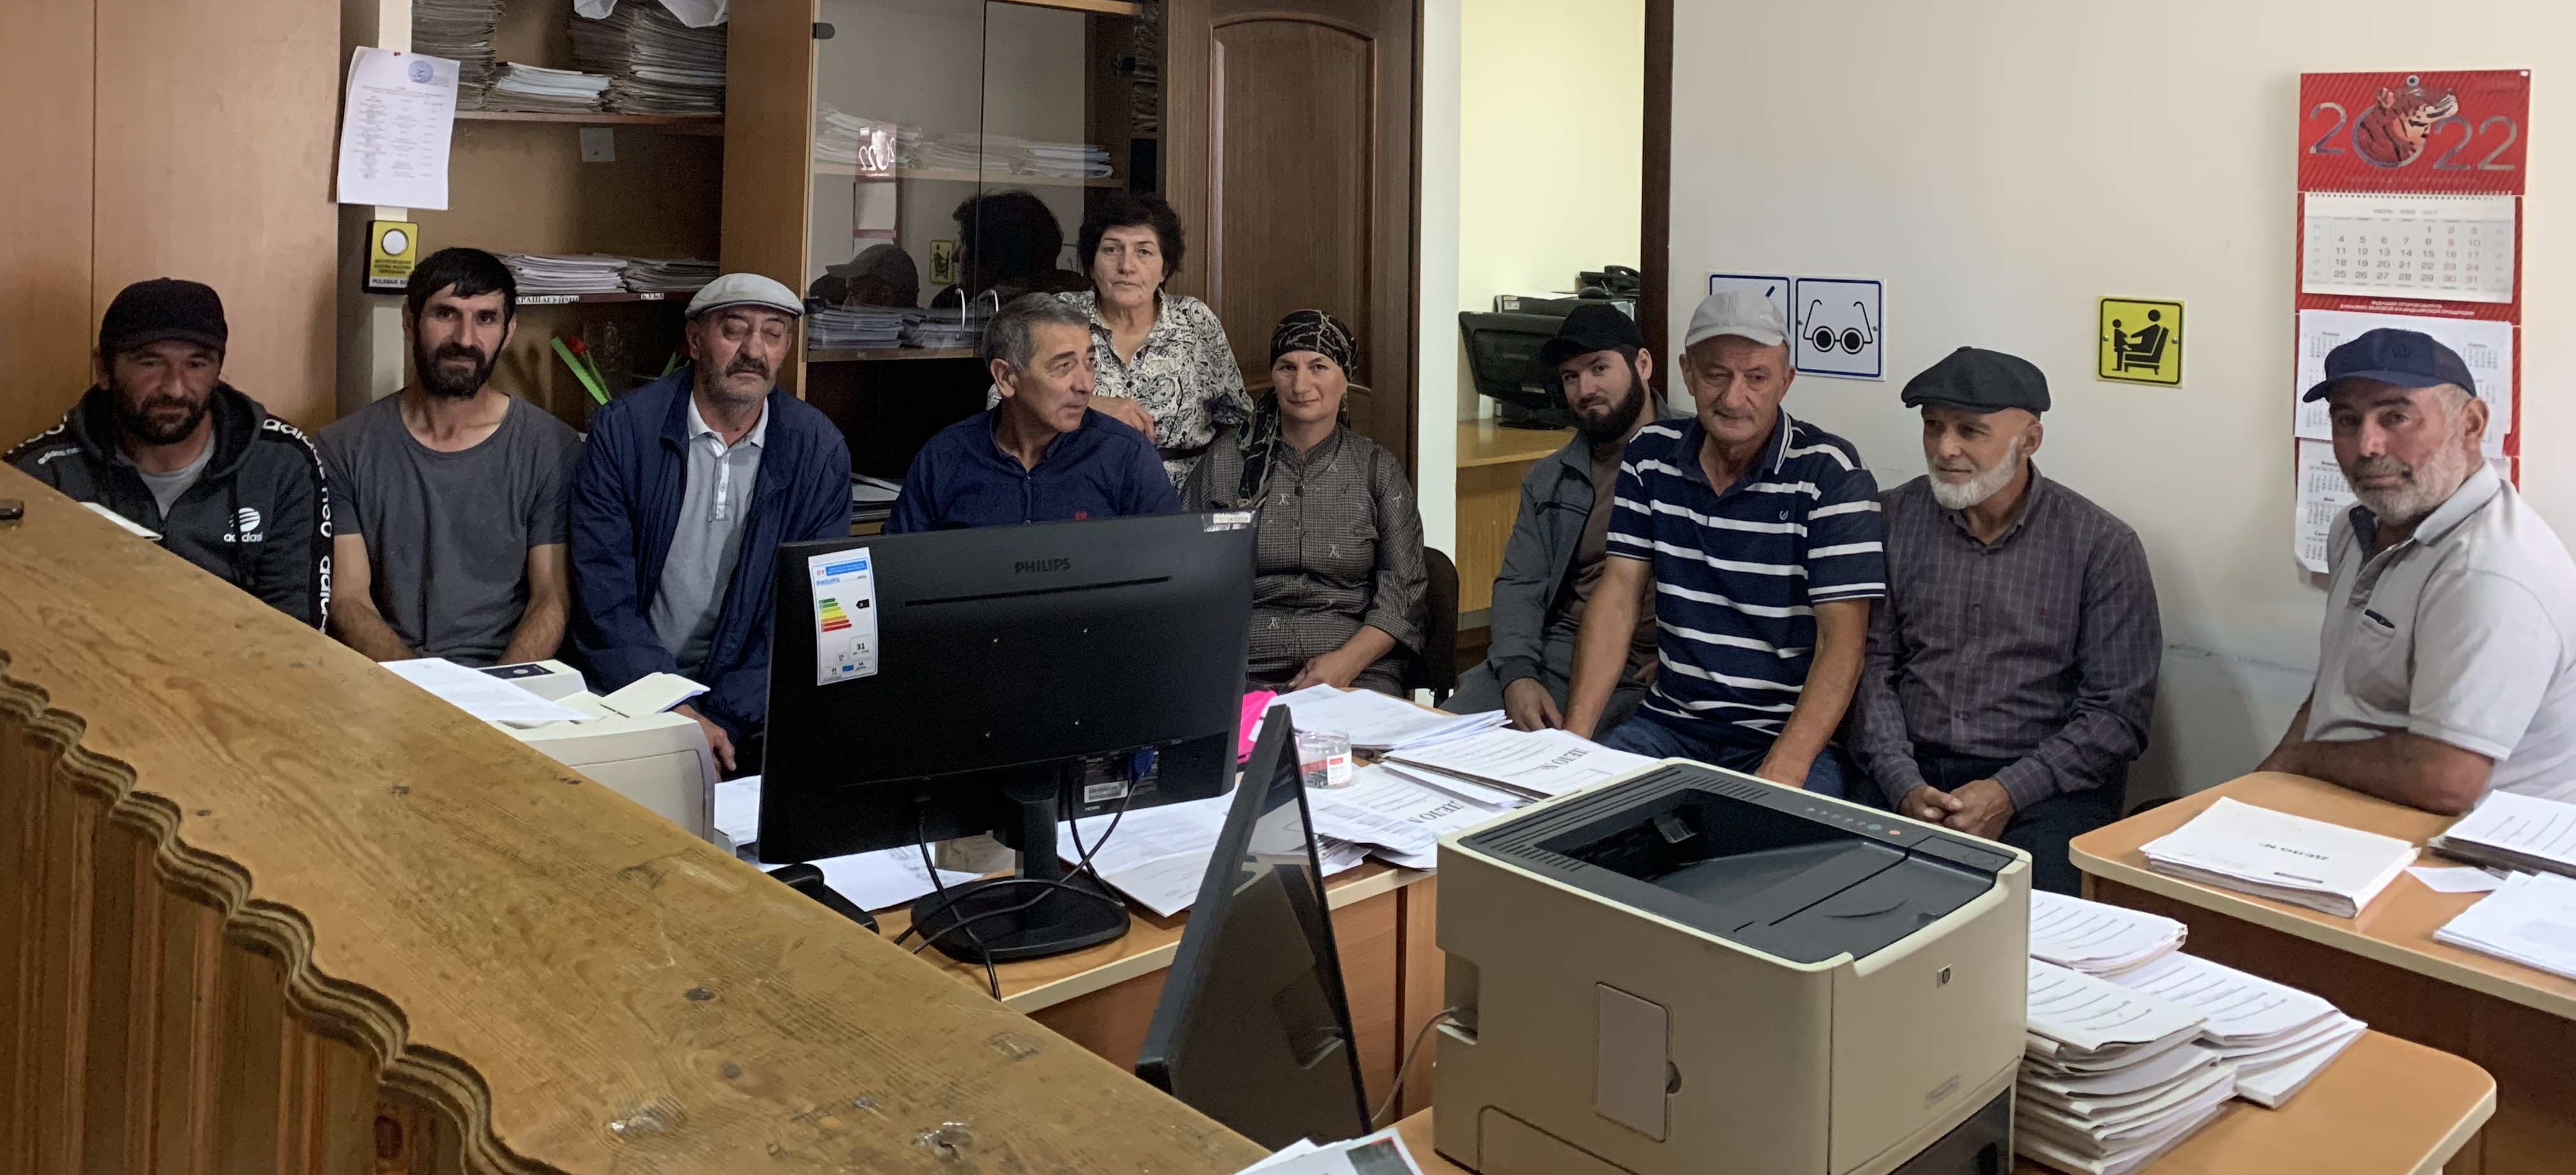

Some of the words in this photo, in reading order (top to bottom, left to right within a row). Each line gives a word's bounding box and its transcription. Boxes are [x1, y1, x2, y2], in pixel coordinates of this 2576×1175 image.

[2310, 102, 2518, 170] 2022
[2468, 251, 2480, 260] 17
[320, 487, 332, 538] neo
[224, 532, 263, 543] adas
[1015, 557, 1070, 573] PHILIPS
[1419, 800, 1465, 820] ДЕЛО
